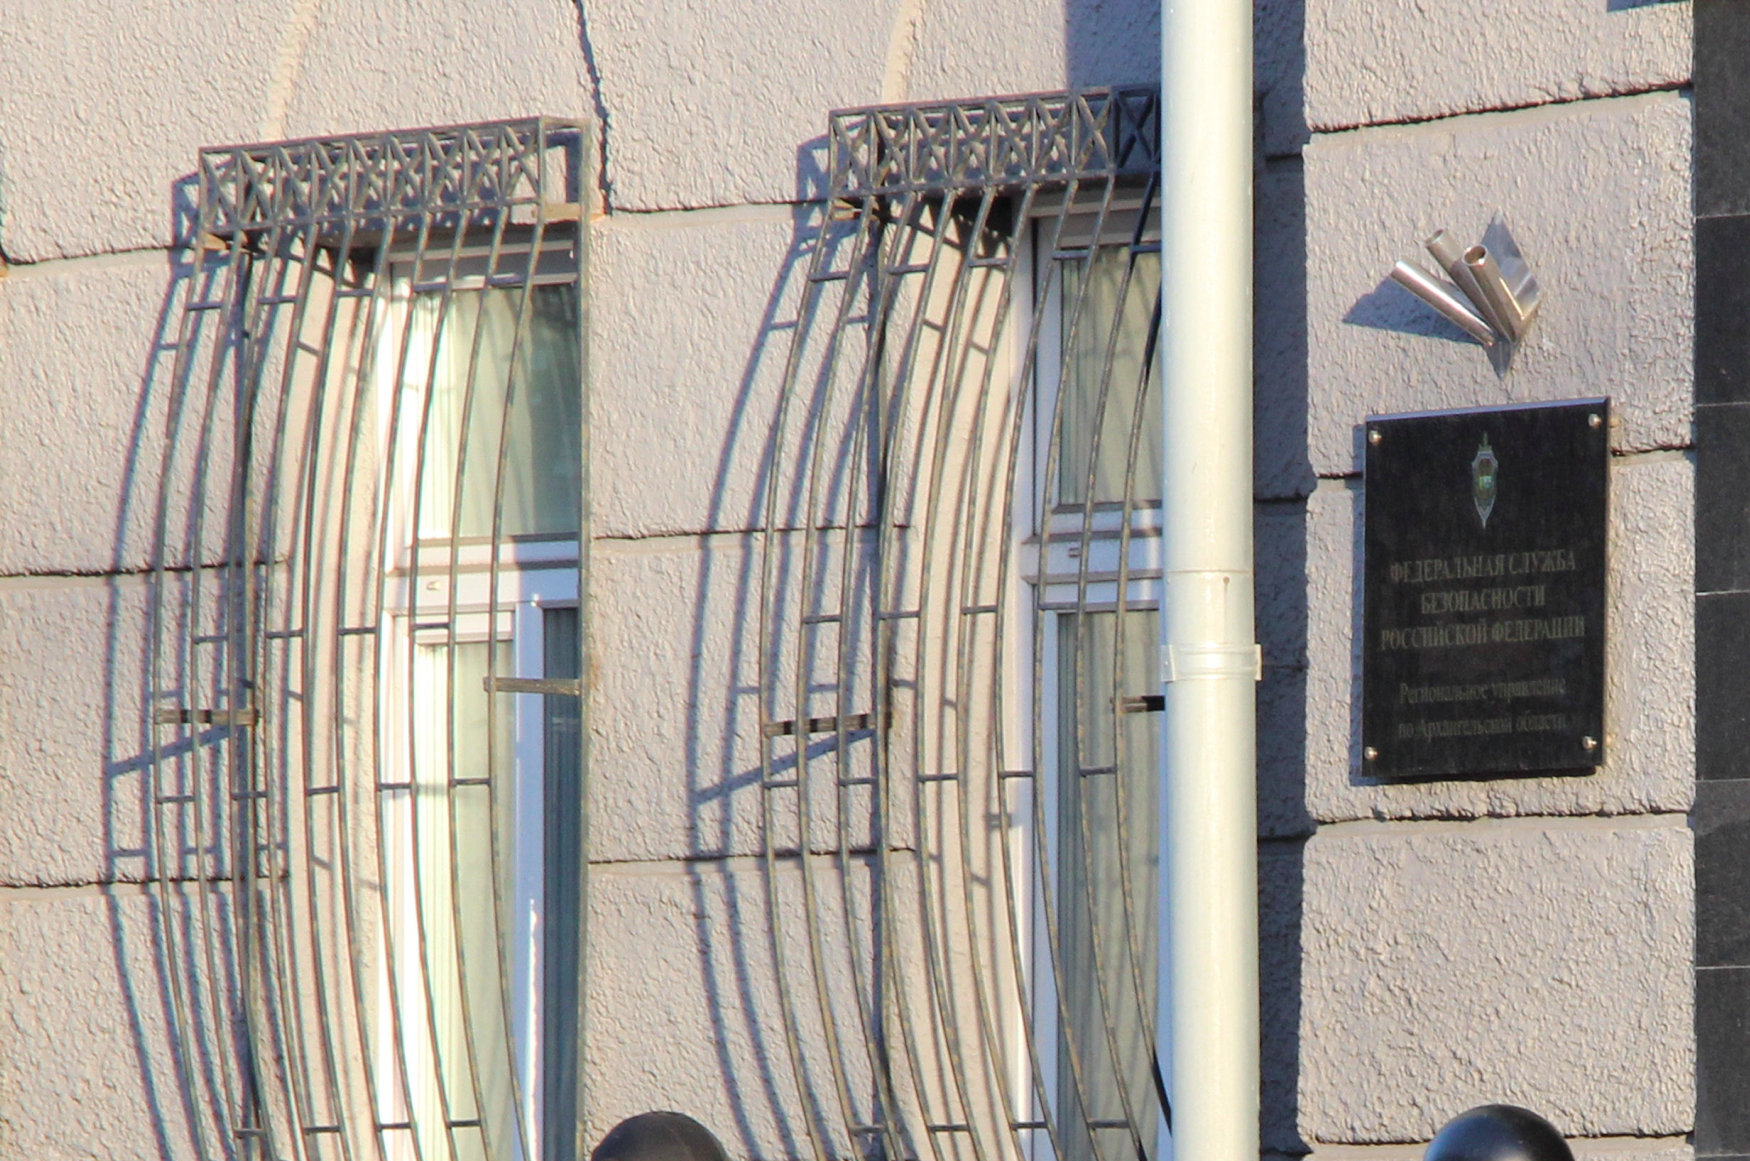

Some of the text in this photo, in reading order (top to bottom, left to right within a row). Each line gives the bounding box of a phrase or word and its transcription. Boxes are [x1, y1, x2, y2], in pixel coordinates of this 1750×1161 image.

[1389, 549, 1577, 583] ФЕДЕРАЛЬНАЯ СЛУЖБА
[1420, 585, 1546, 614] БЕЗОПАСНОСТИ
[1380, 615, 1586, 651] РОССИЙСКОЙ ФЕДЕРАЦИИ
